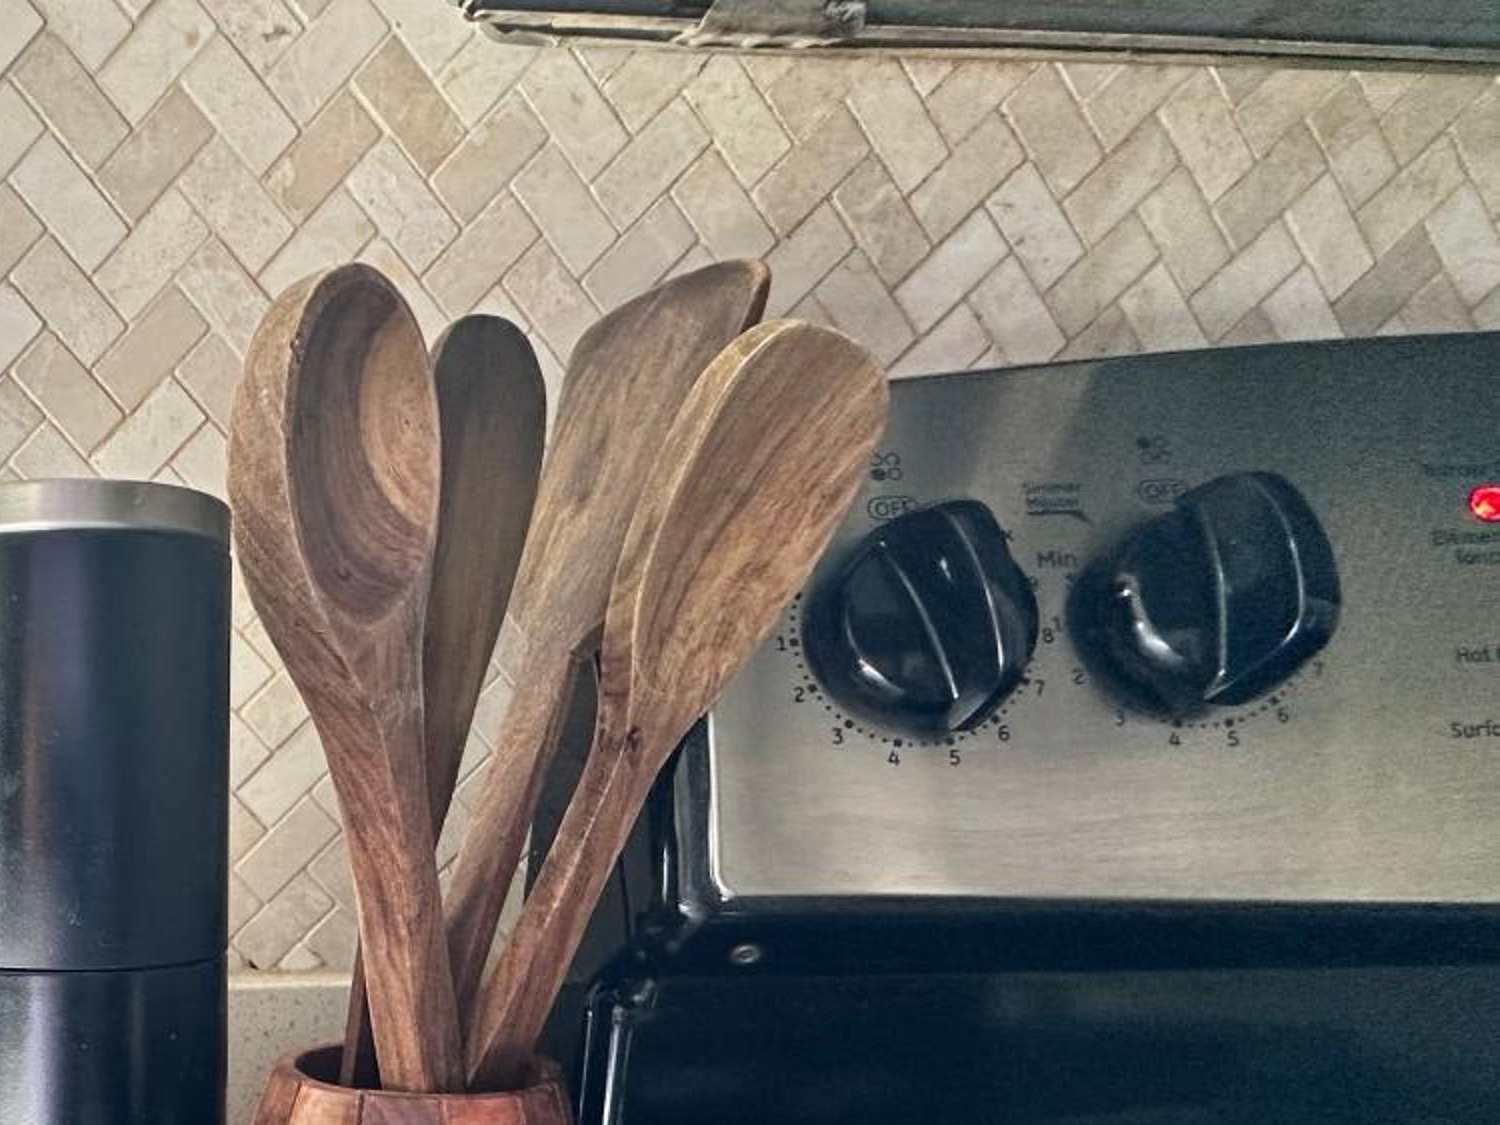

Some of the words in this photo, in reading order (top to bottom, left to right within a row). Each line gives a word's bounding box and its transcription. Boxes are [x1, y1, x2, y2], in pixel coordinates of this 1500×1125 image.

[1037, 551, 1077, 567] Min
[776, 636, 787, 652] 1
[794, 687, 806, 704] 2
[1035, 680, 1045, 697] 7
[1115, 708, 1125, 726] 3
[1277, 708, 1289, 724] 6
[831, 728, 844, 746] 3
[998, 725, 1011, 742] 6
[1169, 732, 1181, 746] 4
[1227, 730, 1239, 747] 5
[887, 750, 901, 767] 4
[949, 749, 961, 766] 5
